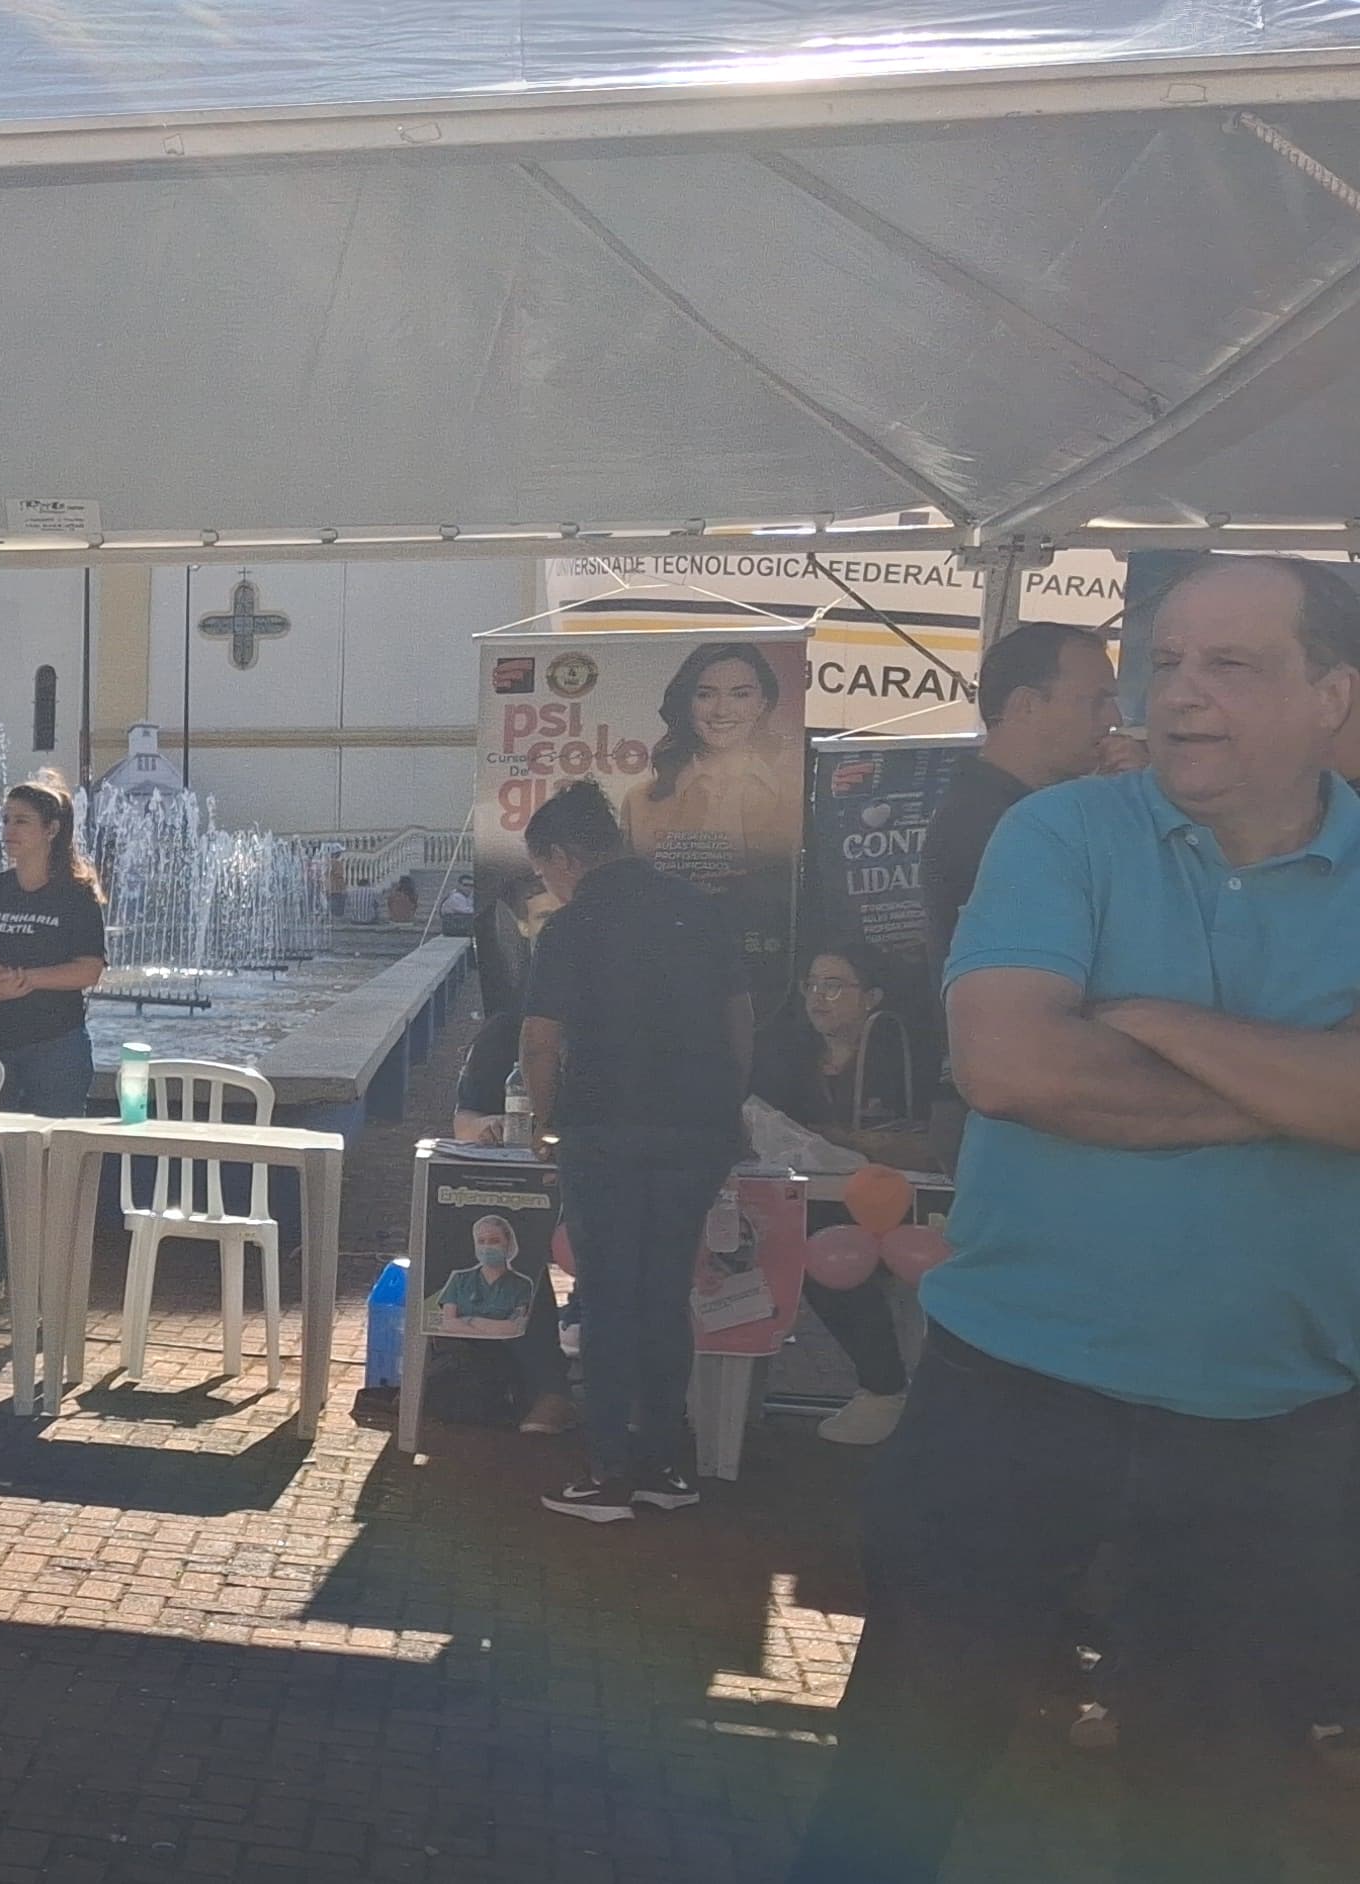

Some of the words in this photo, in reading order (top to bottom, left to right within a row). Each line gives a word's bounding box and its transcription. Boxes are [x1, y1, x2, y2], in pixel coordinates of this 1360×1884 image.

[827, 560, 962, 588] FEDERAL
[504, 703, 583, 754] psi
[486, 752, 527, 764] Curso
[527, 723, 648, 775] colo
